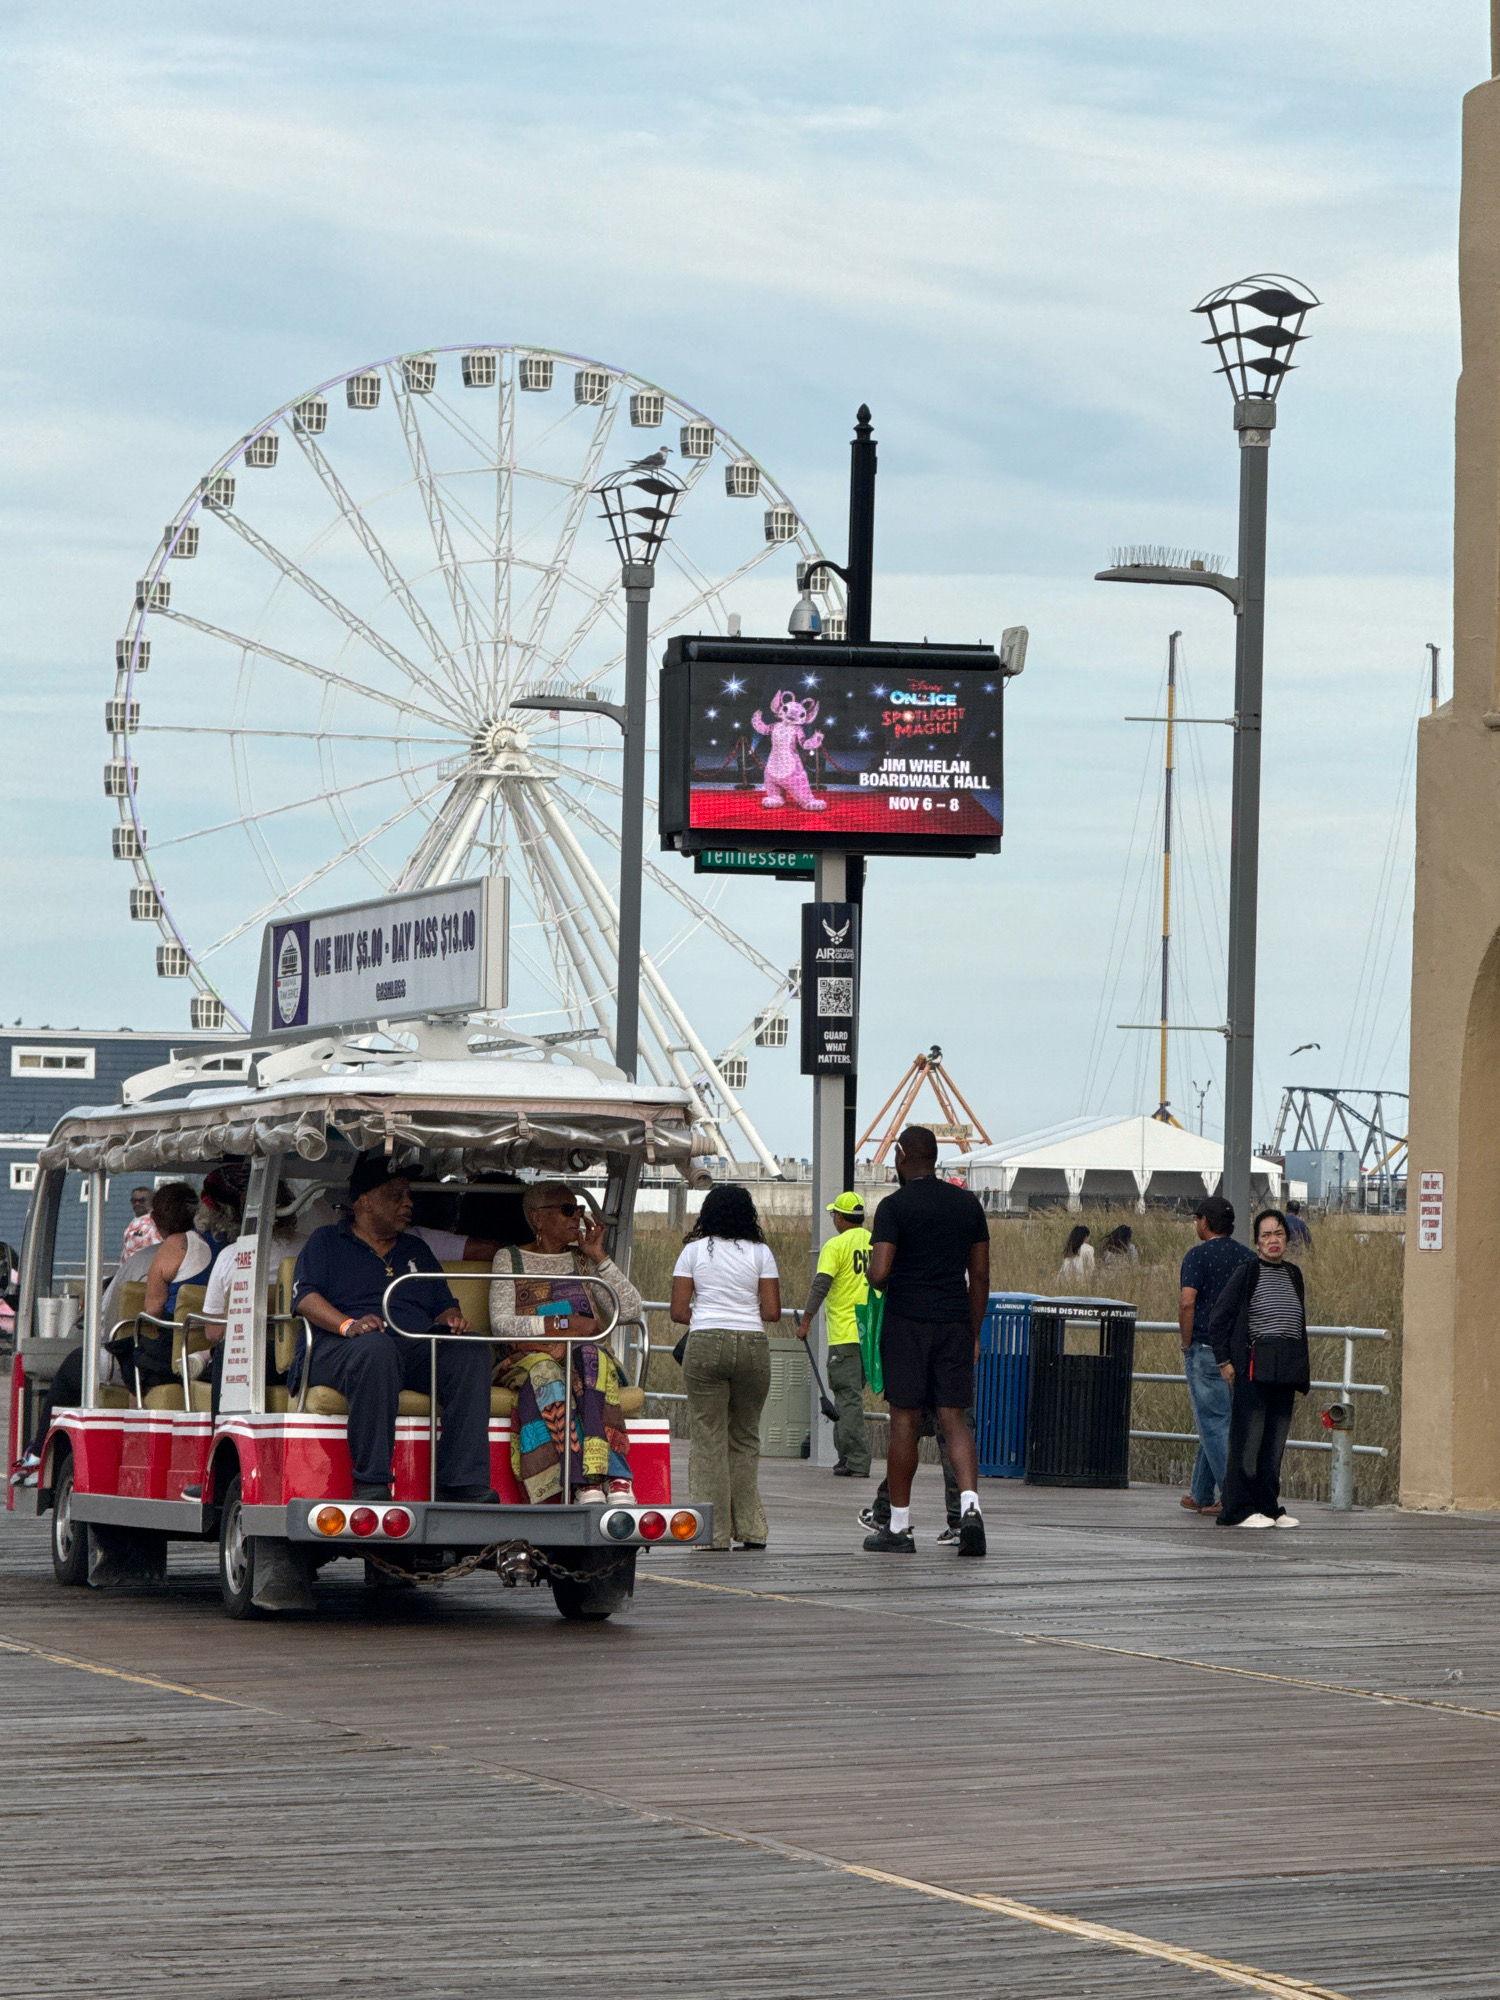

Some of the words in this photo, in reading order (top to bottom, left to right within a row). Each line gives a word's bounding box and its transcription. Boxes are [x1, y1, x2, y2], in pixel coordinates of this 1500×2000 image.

[907, 678, 943, 692] Disney
[890, 690, 917, 705] ON
[929, 692, 957, 706] ICE
[881, 707, 966, 726] SPOTLIGHT
[894, 722, 958, 738] MAGIC!
[879, 758, 906, 772] JIM
[909, 759, 970, 774] WHELAN
[859, 773, 951, 788] BOARDWALK
[954, 775, 990, 789] HALL
[889, 797, 919, 810] NOV
[922, 797, 932, 811] 6
[949, 798, 960, 812] 8
[707, 851, 797, 867] Tennessee
[314, 937, 331, 977] ONE
[334, 932, 354, 973] WAY
[357, 927, 383, 975] $5.00
[392, 921, 412, 963] DAY
[413, 916, 438, 960] PASS
[440, 909, 475, 960] $13.00
[815, 947, 835, 959] AIR
[375, 979, 406, 1001] CASHLESS
[824, 1031, 848, 1040] GUARD
[825, 1043, 846, 1052] WHAT
[818, 1054, 851, 1064] MATTERS.
[237, 1251, 252, 1267] FARE
[233, 1281, 248, 1291] ADULTS
[1032, 1305, 1057, 1314] TOURISM
[1059, 1308, 1099, 1317] DISTRICT
[234, 1324, 243, 1334] KIDS
